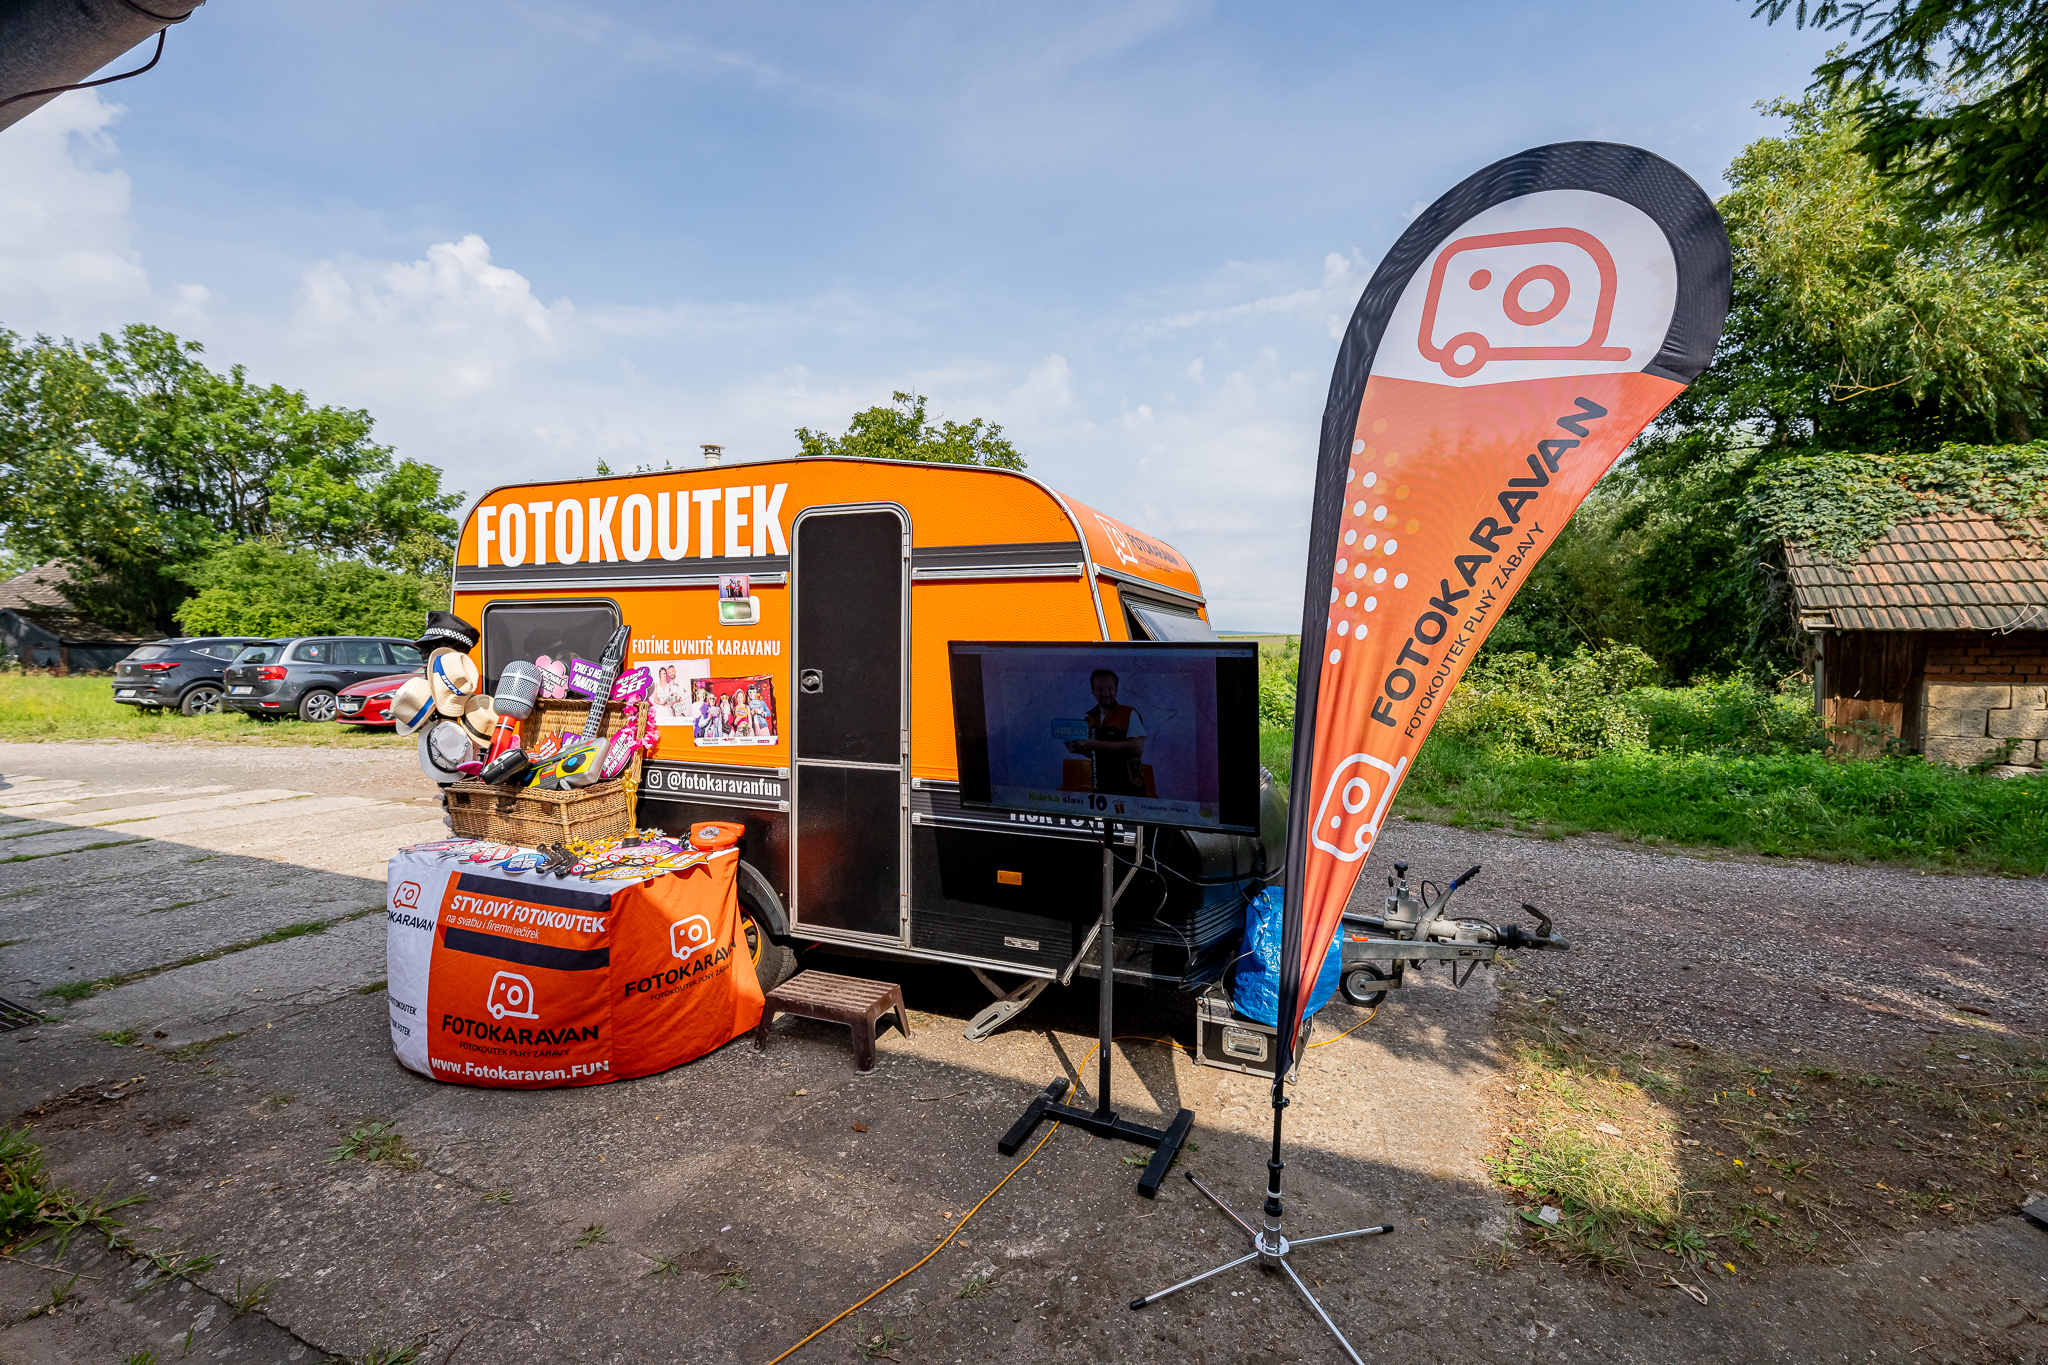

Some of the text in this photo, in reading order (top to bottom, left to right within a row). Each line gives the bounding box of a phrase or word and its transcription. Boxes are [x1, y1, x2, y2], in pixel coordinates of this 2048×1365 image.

[477, 482, 789, 568] FOTOKOUTEK
[1370, 396, 1609, 728] FOTOKARAVAN
[1404, 521, 1545, 739] FOTOKOUTEK PLNÝ ZÁBAVY
[632, 635, 781, 656] FOTÍME UVNITŘ KARAVANU
[667, 771, 781, 796] @fotokaravanfun
[1088, 794, 1107, 811] 10
[450, 894, 606, 933] STYLOVÝ FOTOKOUTEK
[445, 914, 456, 924] na
[457, 917, 482, 928] svatbu
[513, 926, 541, 939] večírek
[650, 980, 697, 1001] FOTOKOUTEK
[442, 1014, 599, 1045] FOTOKARAVAN
[459, 1042, 570, 1058] FOTOKOUTEK PLNÝ ZÁBAVY
[431, 1057, 610, 1081] www.Fotokaravan.FUN
